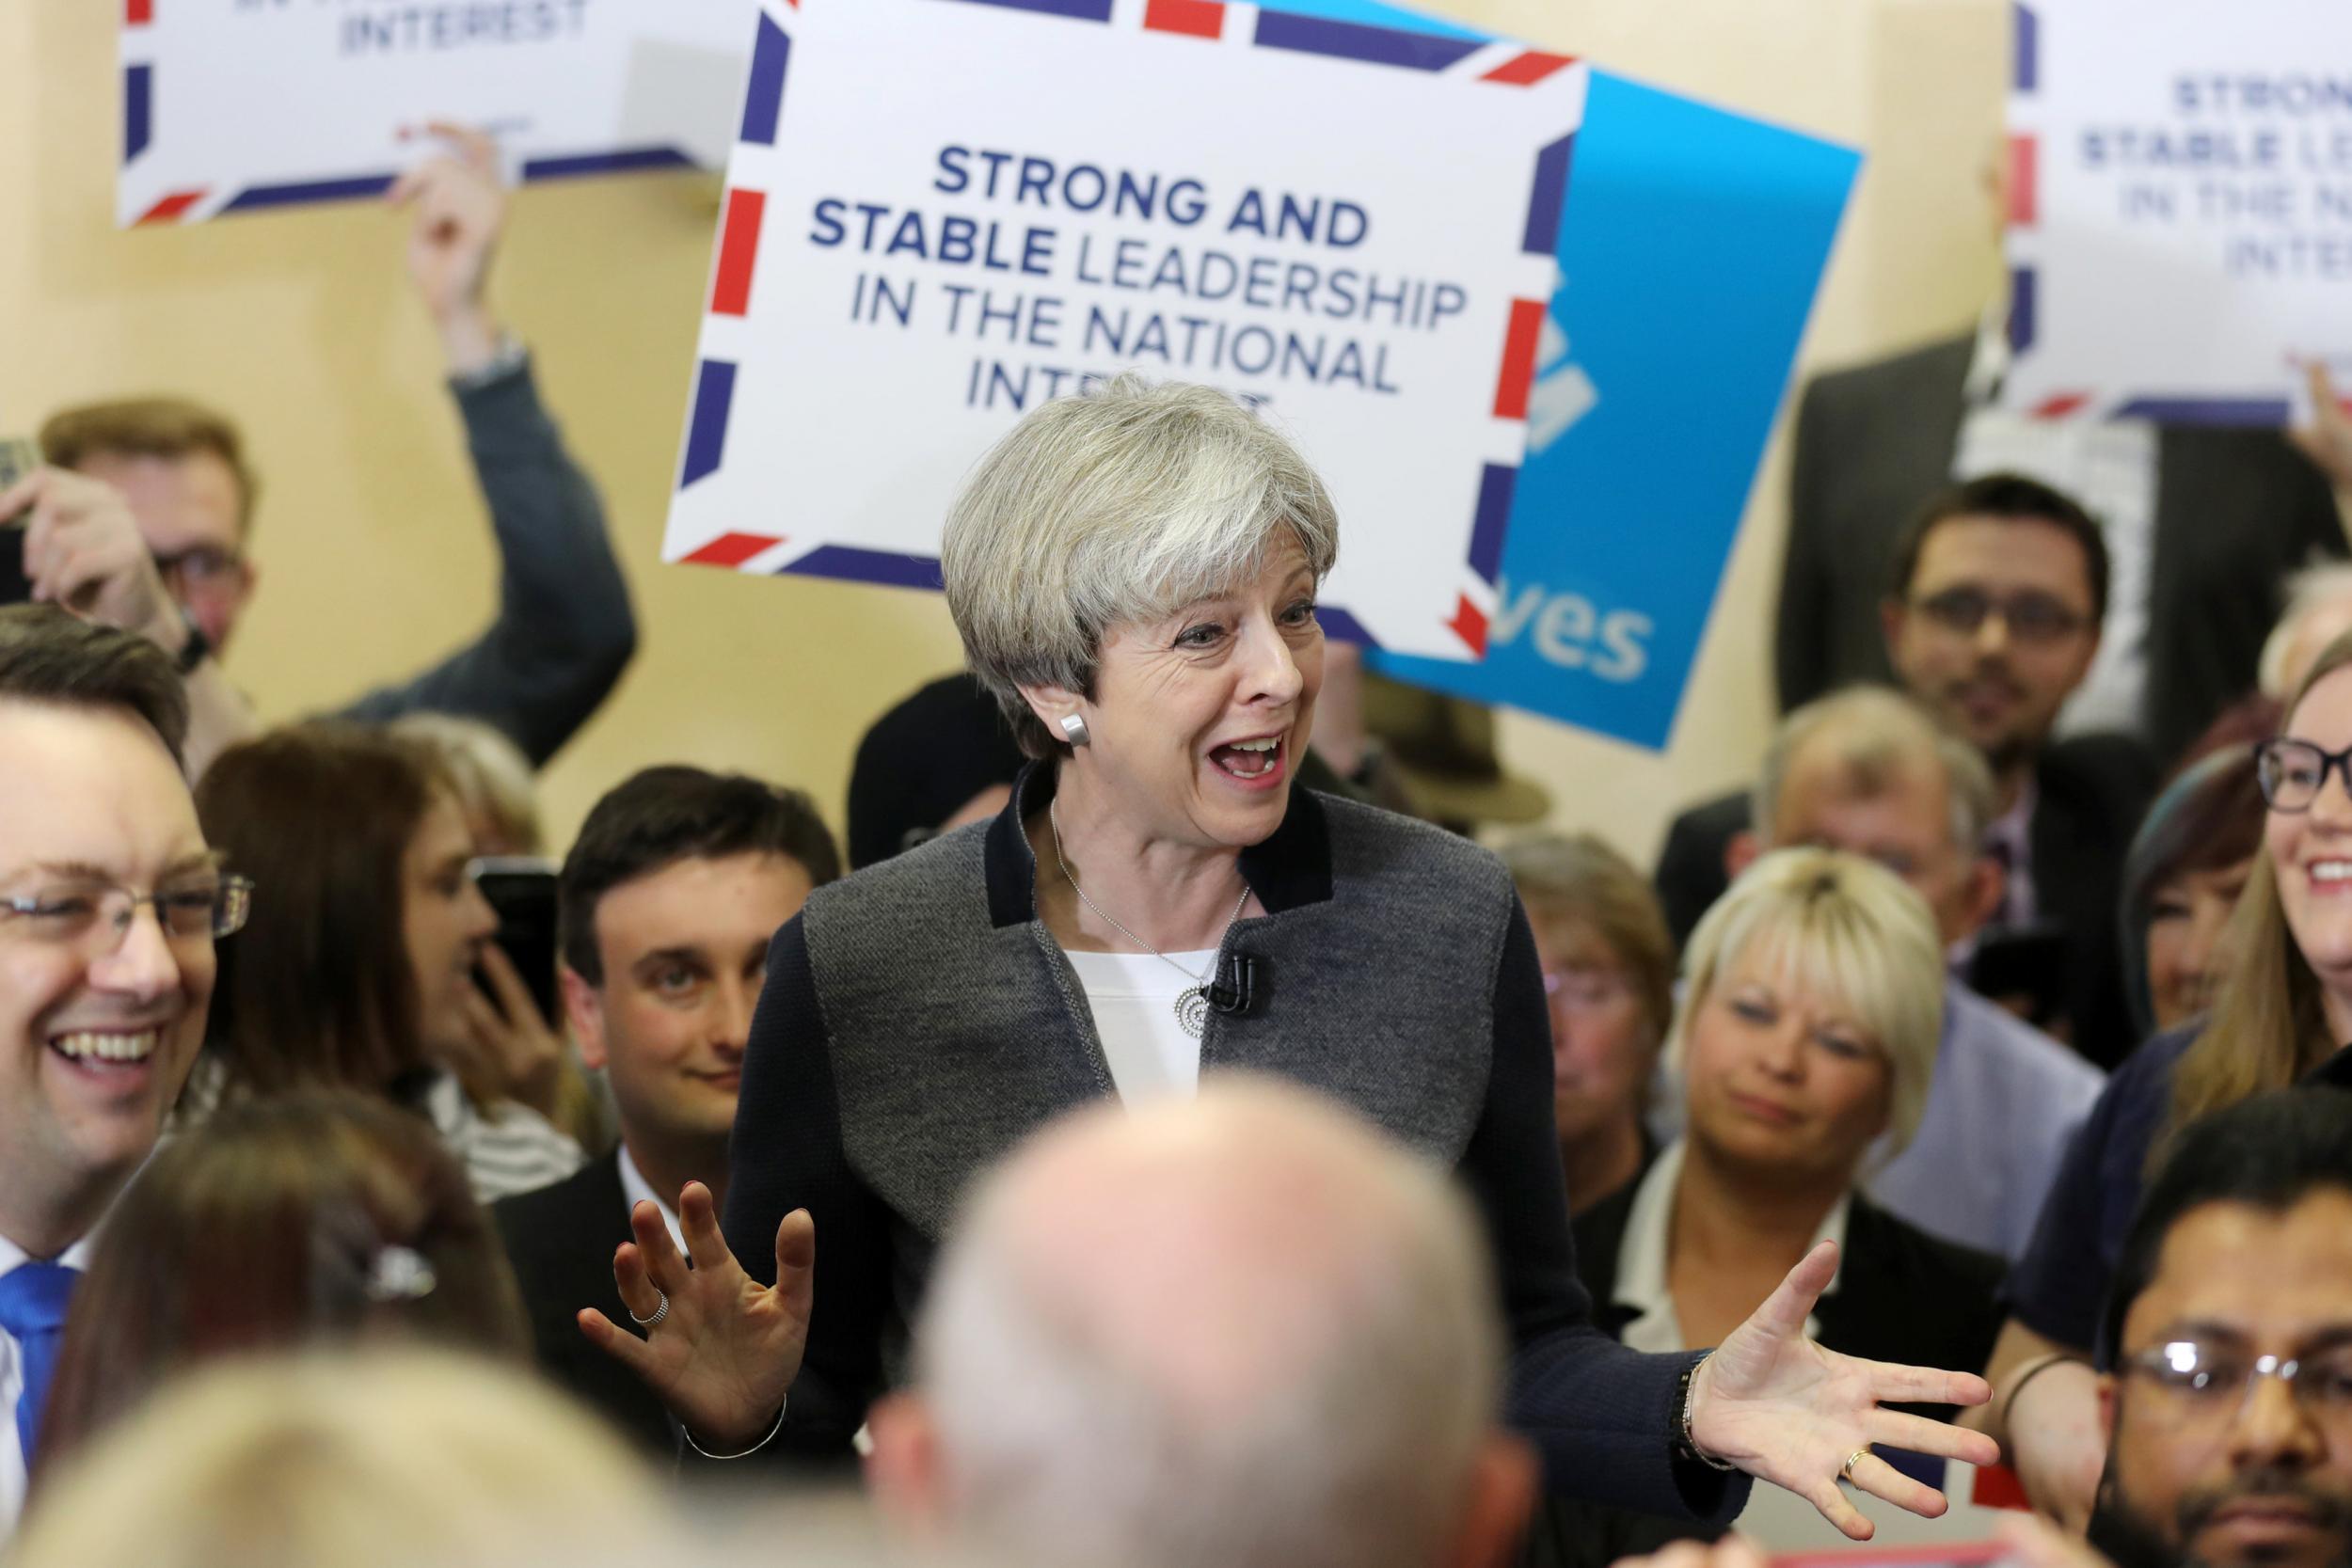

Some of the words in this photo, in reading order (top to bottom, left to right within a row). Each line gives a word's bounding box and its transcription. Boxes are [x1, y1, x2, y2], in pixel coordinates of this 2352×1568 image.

[2175, 74, 2352, 117] STRON
[932, 144, 1210, 229] STRONG
[1225, 186, 1370, 250] AND
[808, 197, 1058, 277] STABLE
[1076, 235, 1468, 329] LEADERSHIP
[851, 273, 916, 327] IN
[943, 284, 1063, 348] THE
[1083, 305, 1399, 394] NATIONAL
